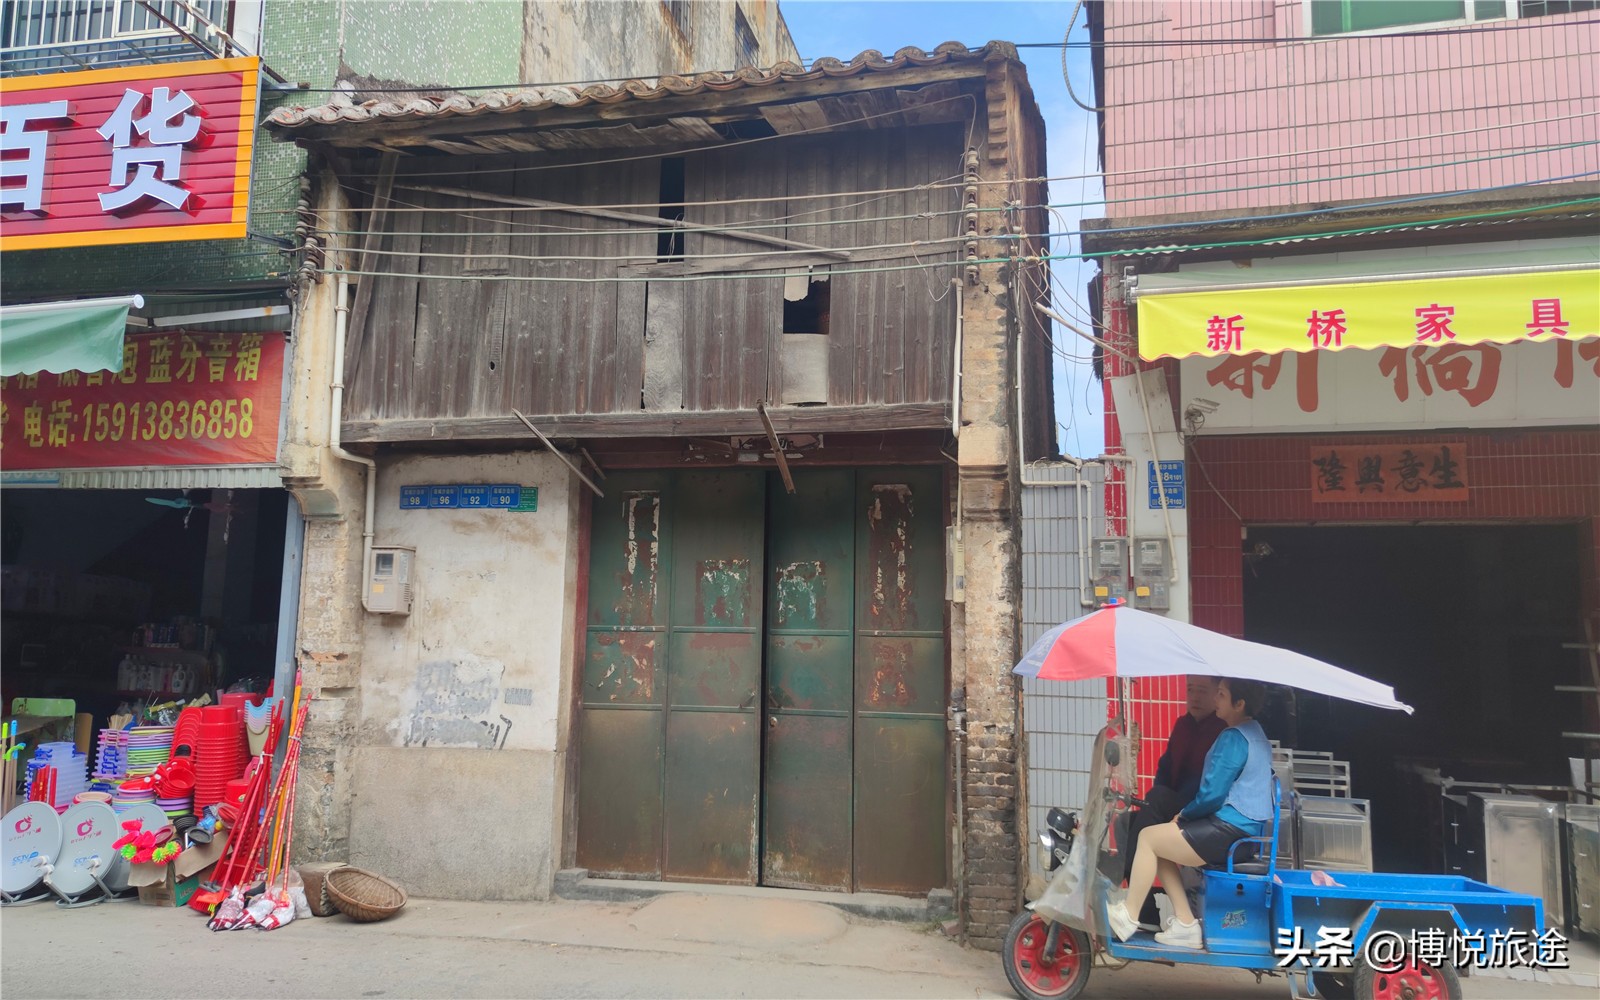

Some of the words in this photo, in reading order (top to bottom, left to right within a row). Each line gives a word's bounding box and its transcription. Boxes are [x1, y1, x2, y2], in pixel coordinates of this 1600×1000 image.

[0, 87, 201, 211] 百货
[1206, 300, 1570, 353] 新桥家具
[145, 333, 264, 384] 蓝牙音箱
[439, 496, 450, 505] 96
[470, 496, 480, 505] 92
[500, 496, 510, 505] 90
